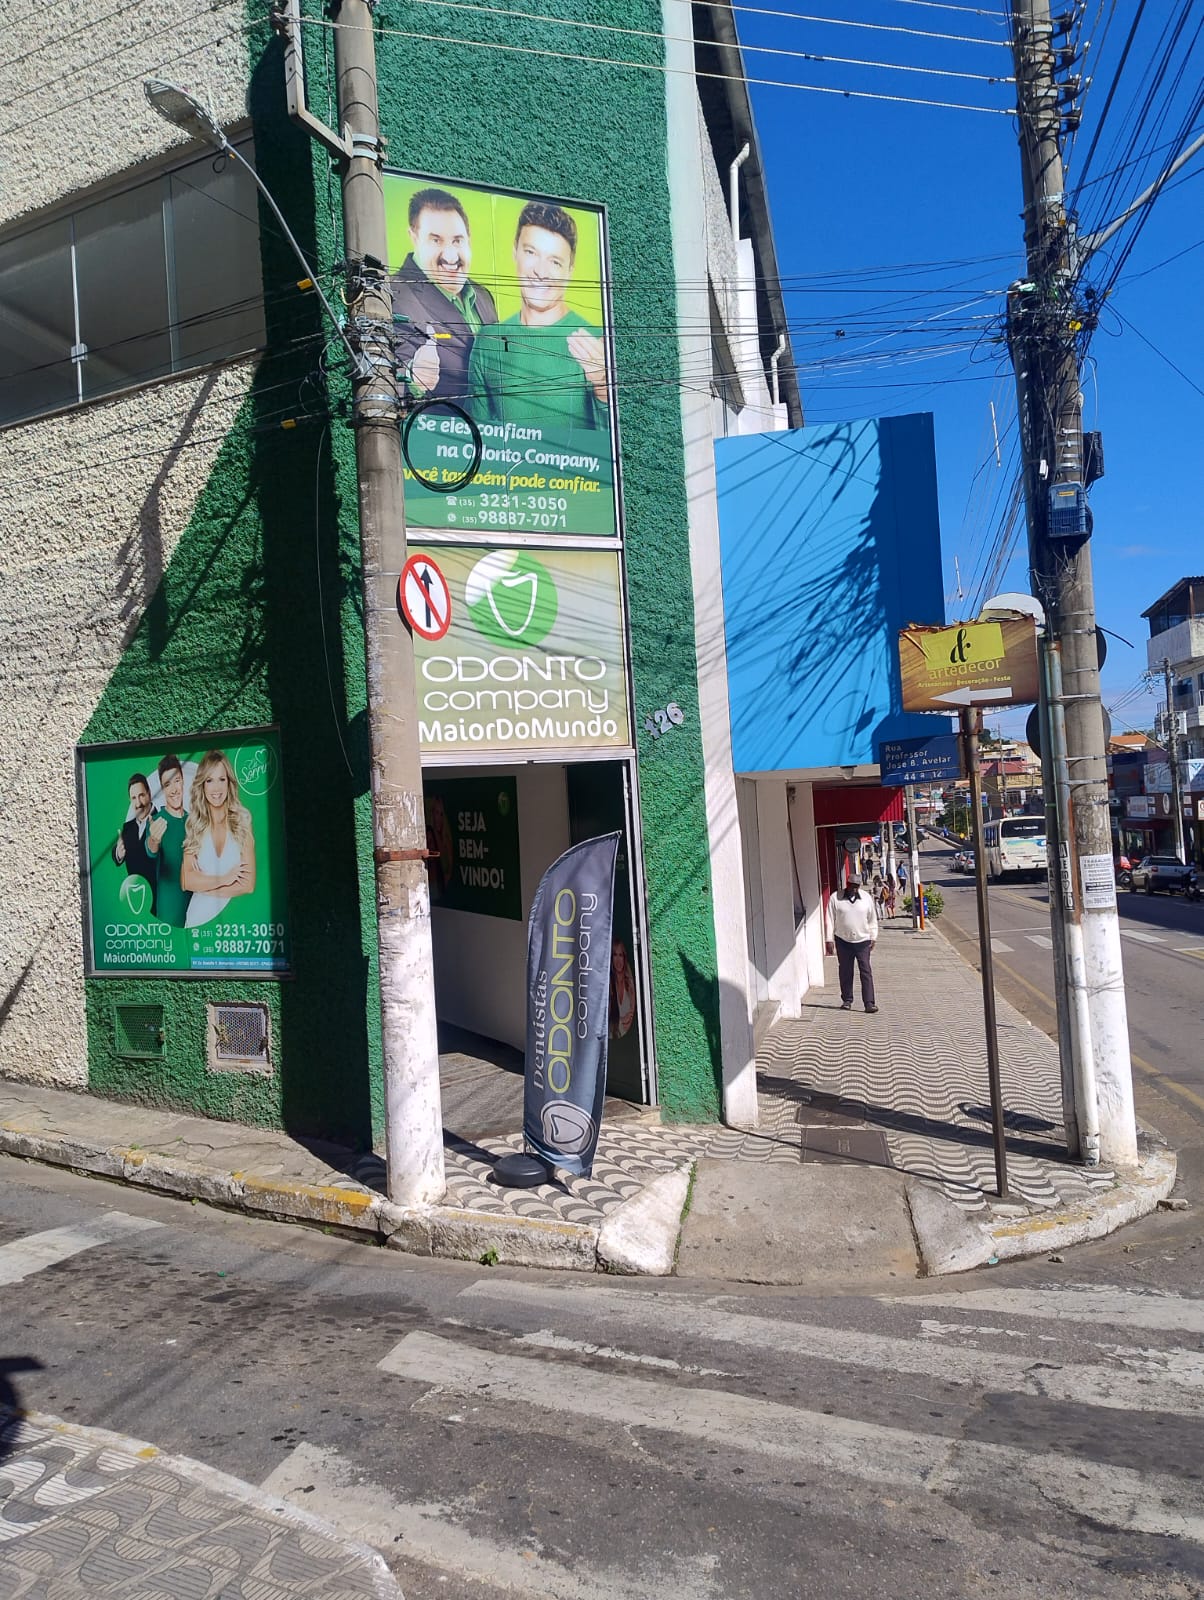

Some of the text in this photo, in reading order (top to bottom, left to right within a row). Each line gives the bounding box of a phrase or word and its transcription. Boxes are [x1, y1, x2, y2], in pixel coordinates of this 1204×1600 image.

[417, 414, 542, 442] Se eles confiam
[436, 444, 459, 458] na
[524, 448, 600, 472] Company,
[509, 473, 546, 490] pode
[549, 475, 601, 494] confiar.
[459, 493, 568, 511] (35) 3231-3050
[462, 510, 567, 527] (35) 98887-7071
[421, 655, 607, 682] ODONTO
[928, 658, 1002, 680] artedecor
[423, 688, 609, 715] company
[418, 715, 618, 743] MaiorDoMundo
[885, 744, 902, 752] Rua
[885, 750, 928, 761] Professor
[922, 756, 952, 765] Avelar
[457, 811, 487, 832] SEJA
[458, 838, 489, 860] BEM-
[459, 865, 505, 890] VINDO!
[105, 923, 172, 936] ODONTO
[215, 923, 285, 937] 3231-3050
[105, 939, 173, 951] company
[214, 940, 285, 953] 98887-7071
[103, 952, 176, 963] MaiorDoMundo
[577, 893, 598, 1039] company
[547, 888, 577, 1094] ODONTO
[532, 970, 549, 1091] Dentistas
